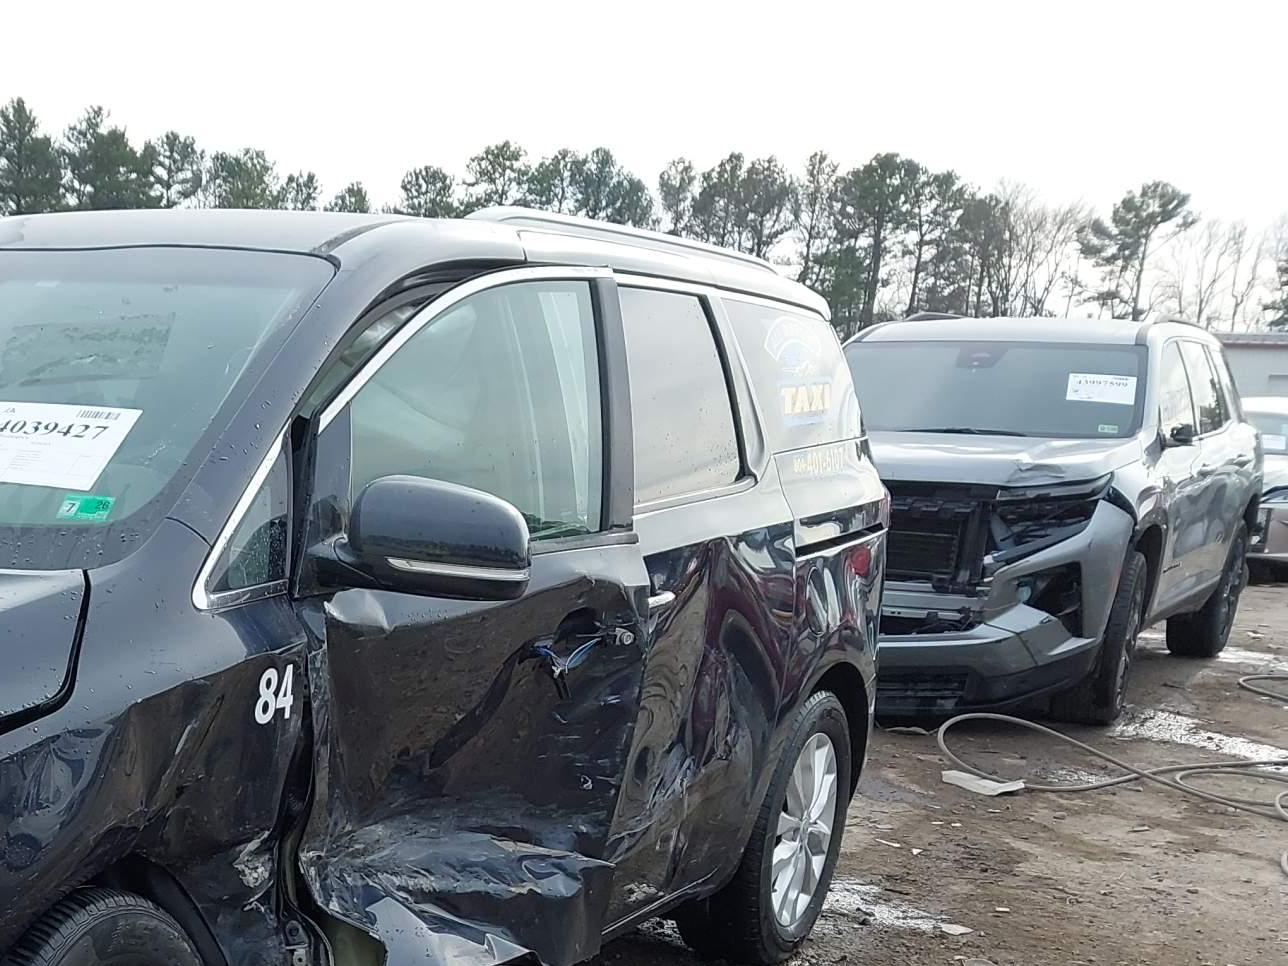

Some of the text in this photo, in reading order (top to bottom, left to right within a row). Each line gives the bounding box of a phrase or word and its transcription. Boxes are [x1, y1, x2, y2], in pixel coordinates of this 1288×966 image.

[781, 383, 832, 415] TAXI
[66, 500, 110, 513] 7 26
[255, 664, 293, 724] 84
